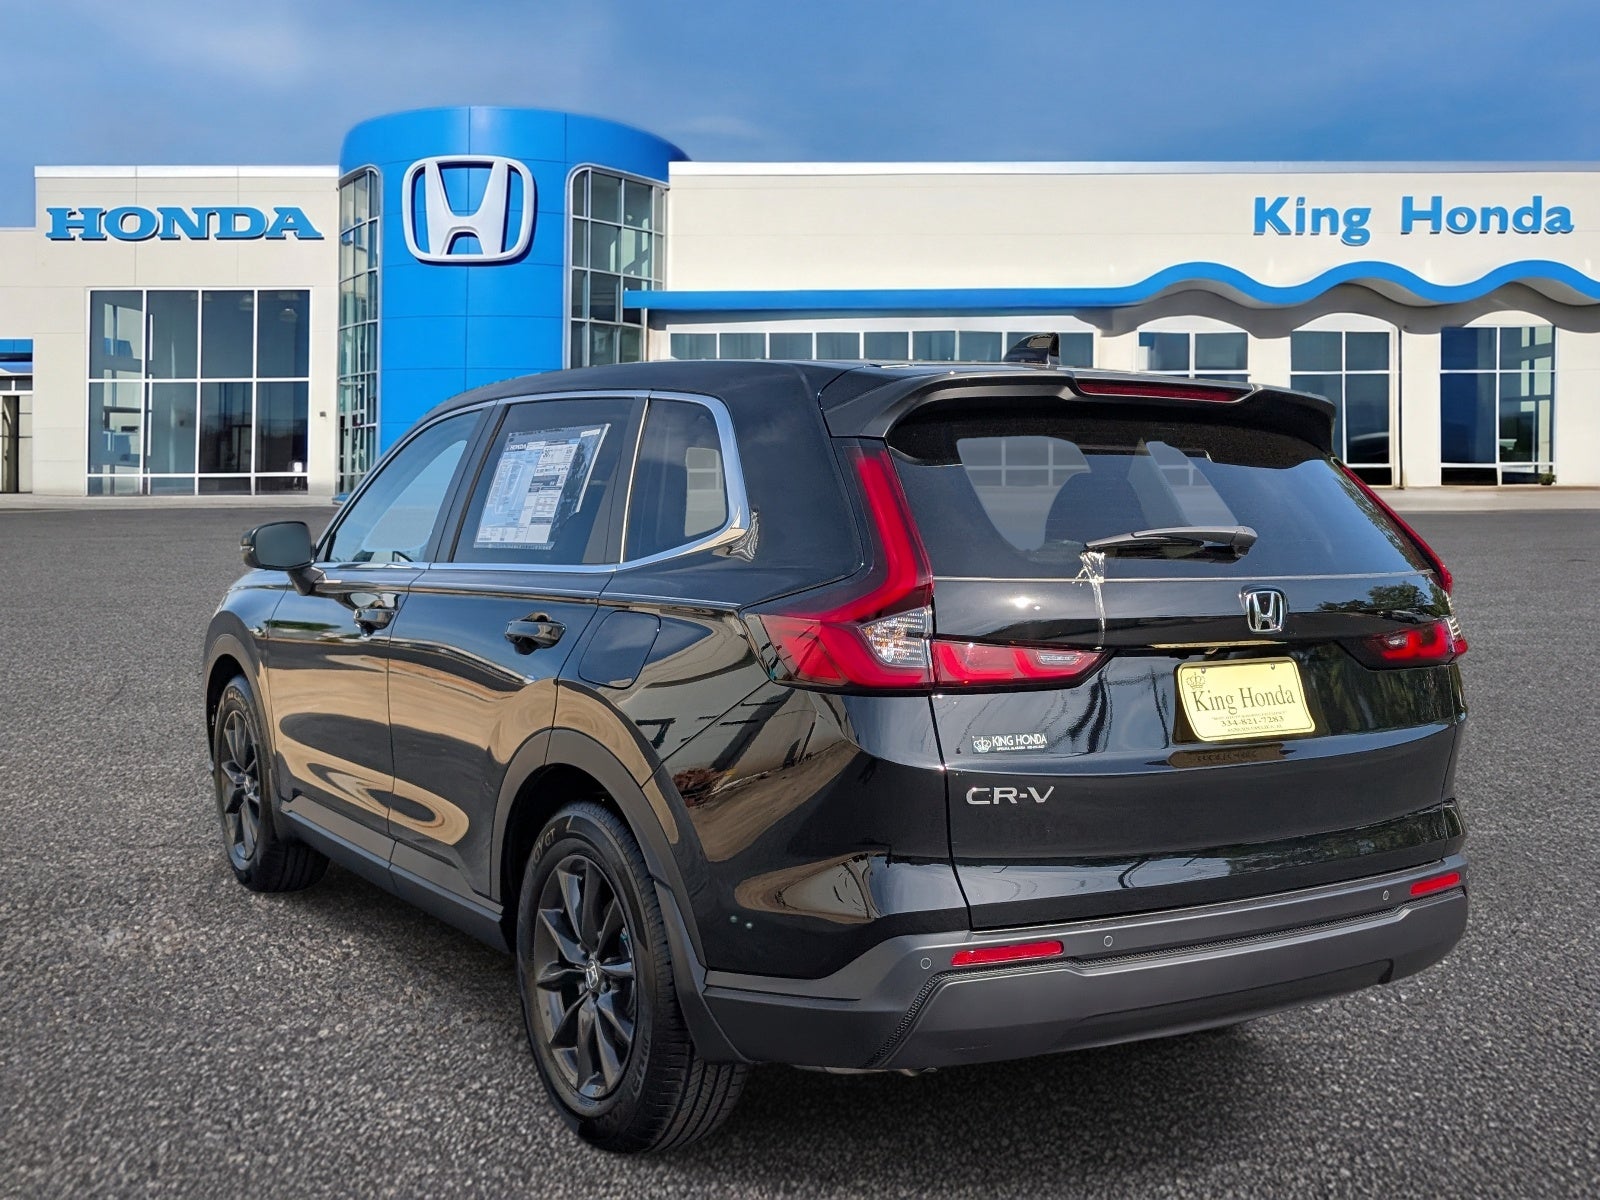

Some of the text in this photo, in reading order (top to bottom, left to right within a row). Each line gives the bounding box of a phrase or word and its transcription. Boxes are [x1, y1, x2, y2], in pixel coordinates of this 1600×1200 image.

[46, 207, 324, 241] HONDA
[1253, 195, 1575, 247] King Honda
[1192, 685, 1296, 715] King Honda
[992, 733, 1048, 747] KING HONDA
[965, 785, 1055, 805] CR-V
